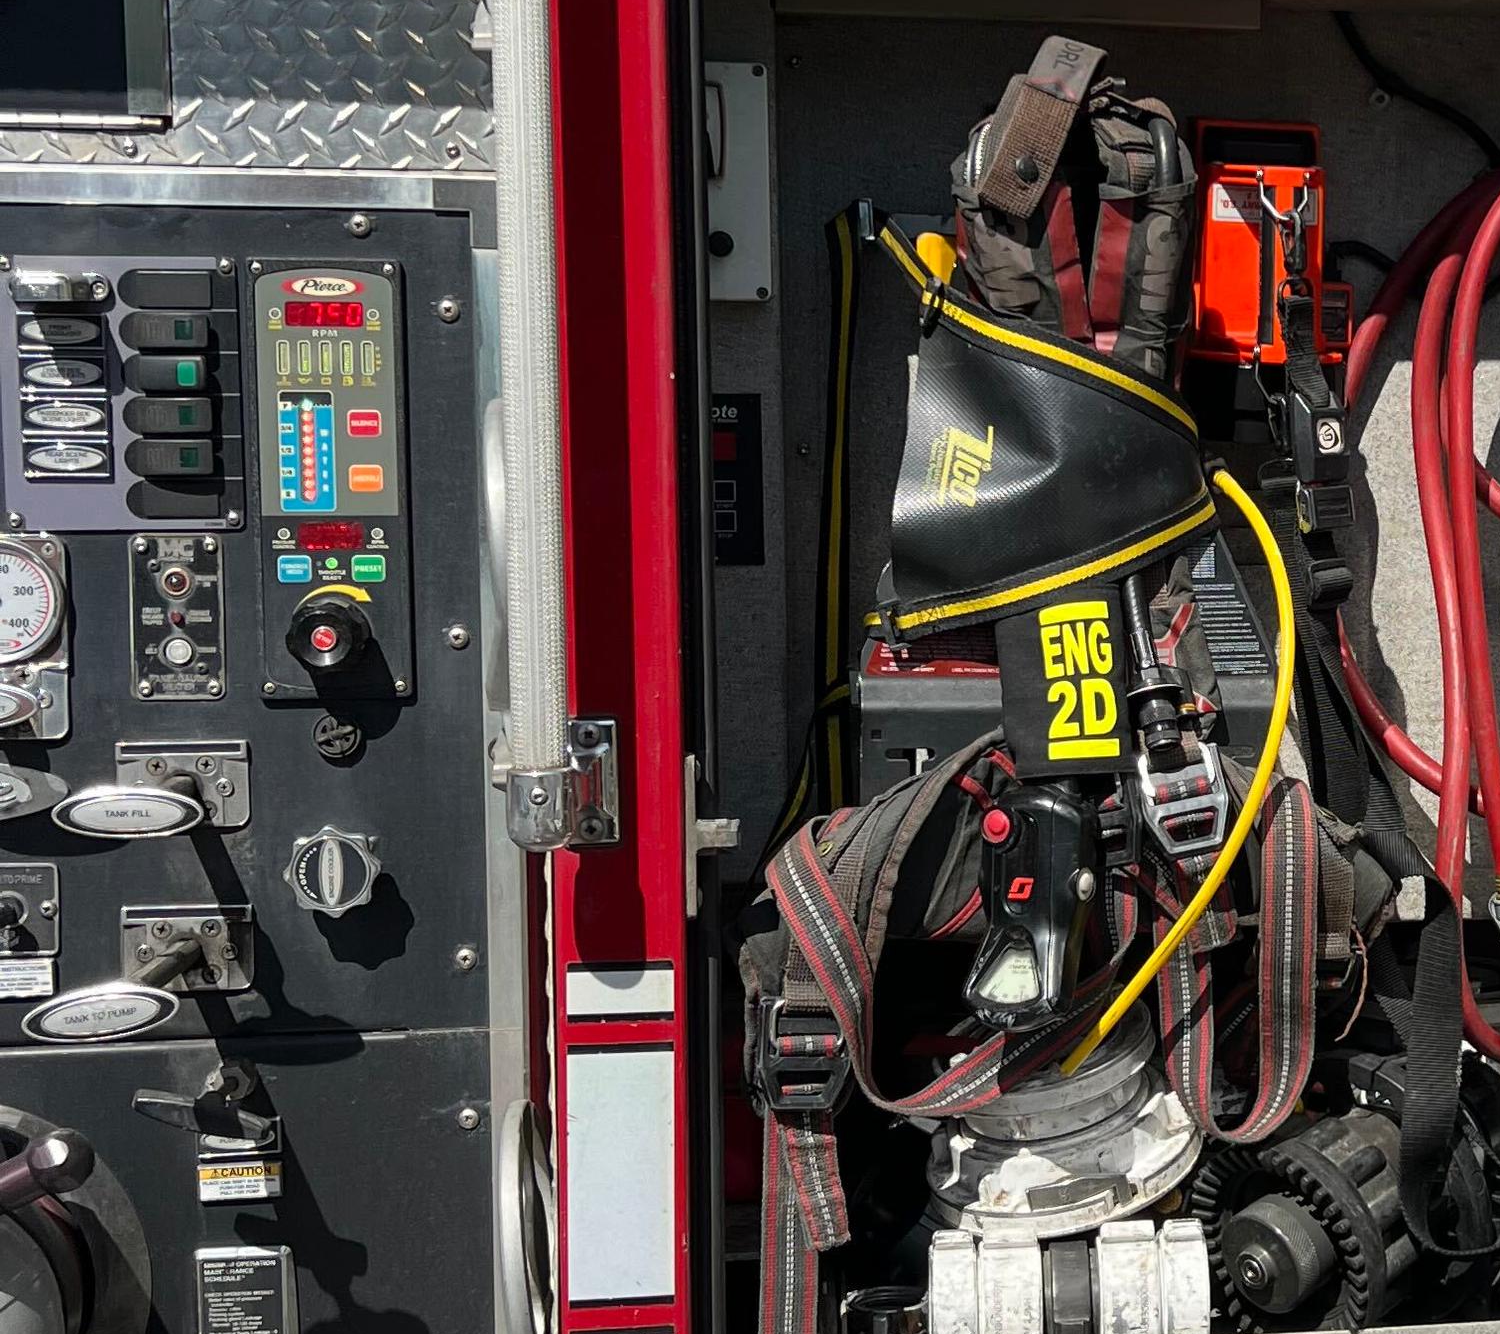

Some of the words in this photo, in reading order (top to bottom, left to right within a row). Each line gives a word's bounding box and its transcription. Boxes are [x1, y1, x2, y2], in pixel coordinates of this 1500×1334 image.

[299, 278, 346, 293] Pierce
[311, 329, 338, 338] RPM
[711, 404, 739, 419] ote
[13, 585, 34, 596] 300
[8, 618, 30, 628] 400
[1040, 620, 1113, 679] ENG
[1047, 678, 1117, 740] 2D
[105, 810, 128, 818] TANK
[131, 809, 152, 817] FILL
[0, 873, 43, 885] TOPRIME
[299, 861, 308, 885] OPEN
[64, 1012, 89, 1025] TANK
[93, 1010, 107, 1020] TO
[108, 1007, 138, 1019] PUMP
[220, 1166, 272, 1177] CAUTION
